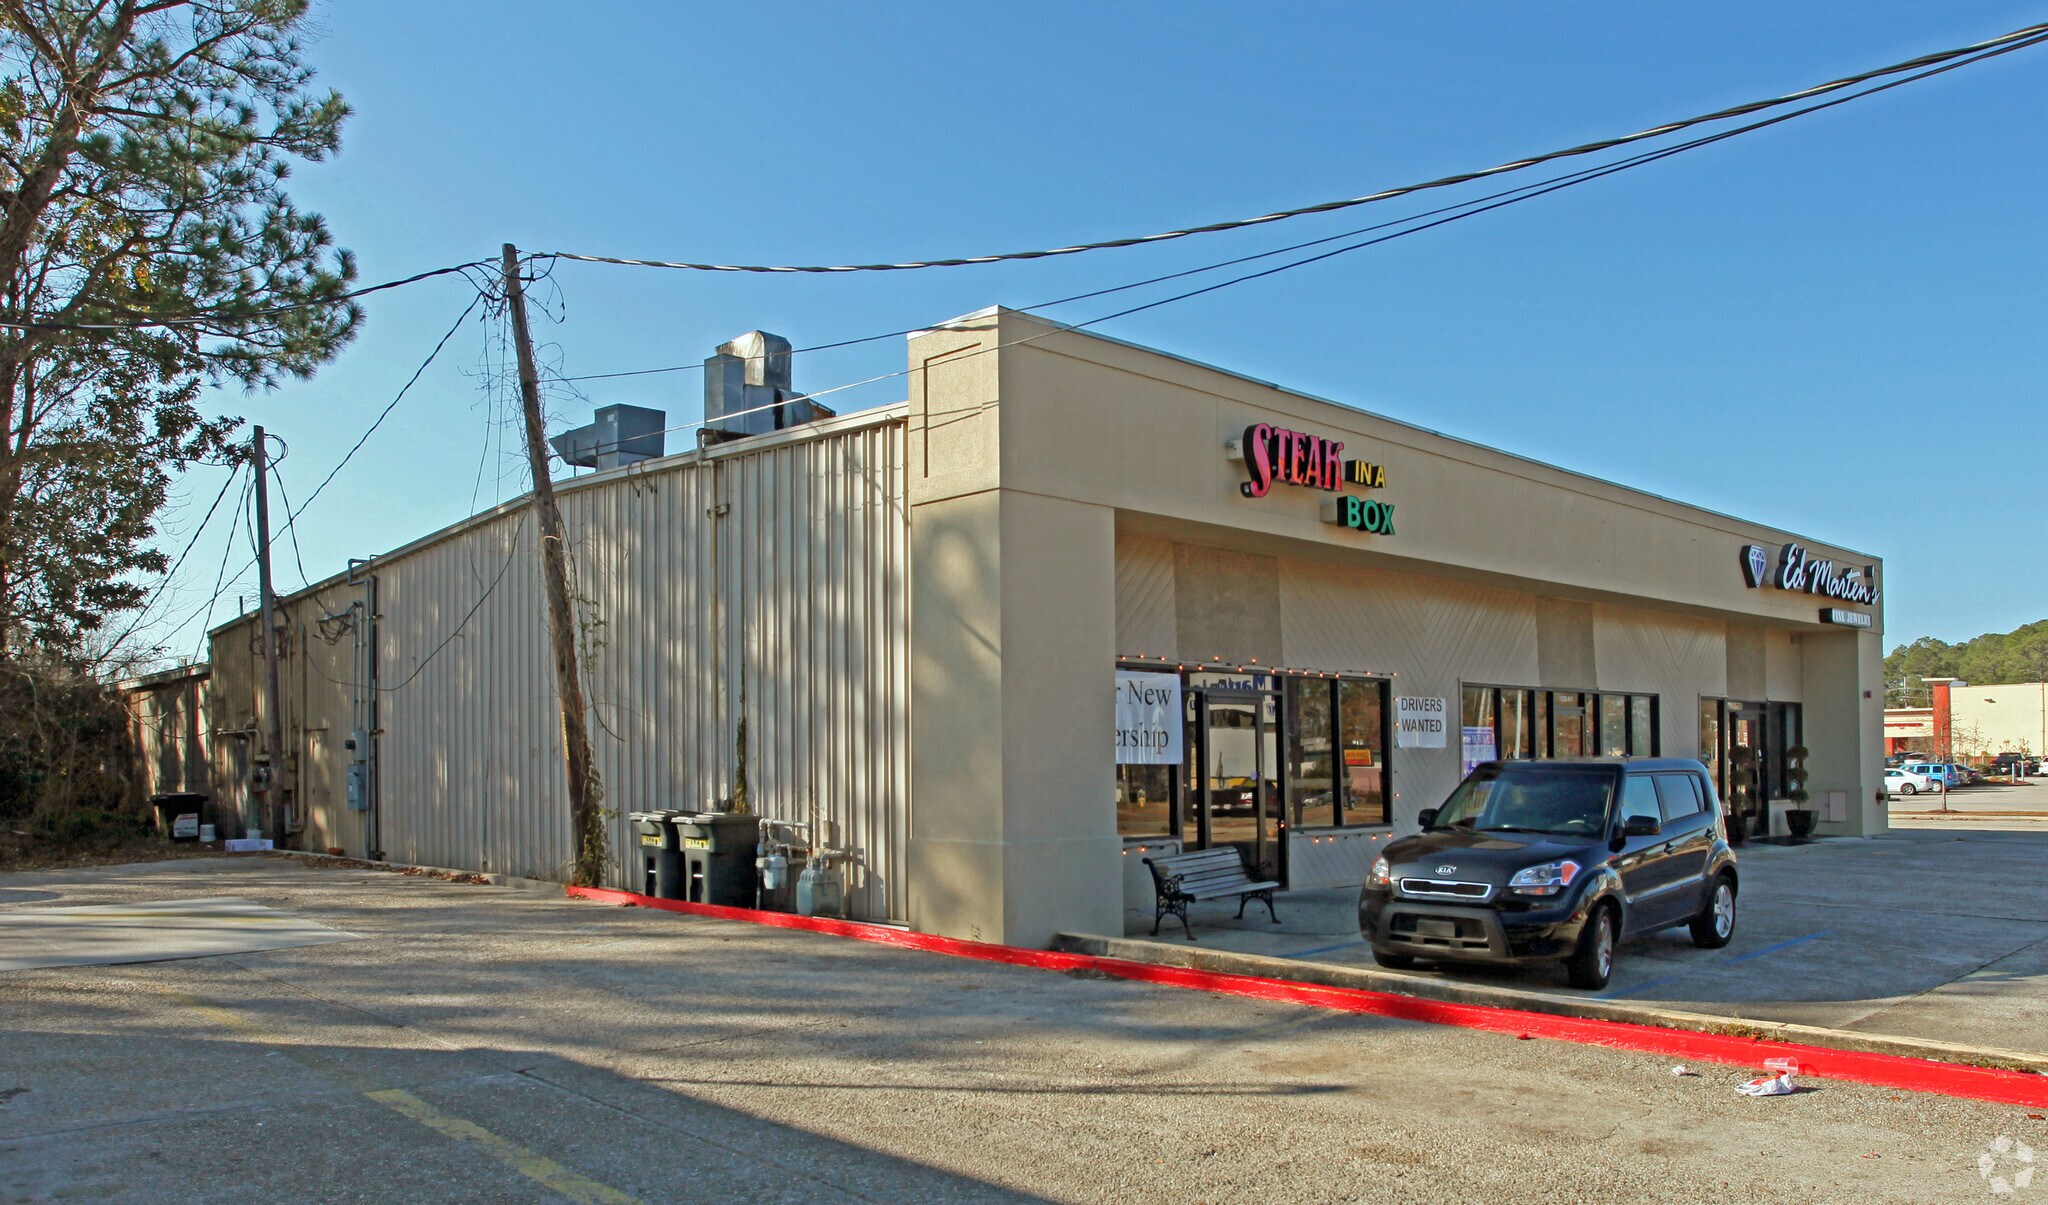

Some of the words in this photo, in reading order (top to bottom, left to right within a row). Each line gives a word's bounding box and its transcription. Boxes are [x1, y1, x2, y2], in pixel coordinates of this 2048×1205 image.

[1249, 422, 1345, 498] STEAK
[1354, 459, 1373, 485] IN
[1374, 465, 1387, 488] A
[1347, 495, 1396, 536] BOX
[1783, 542, 1807, 590] Ed
[1127, 680, 1173, 706] New
[1401, 698, 1442, 712] DRIVERS
[1401, 719, 1442, 733] WANTED
